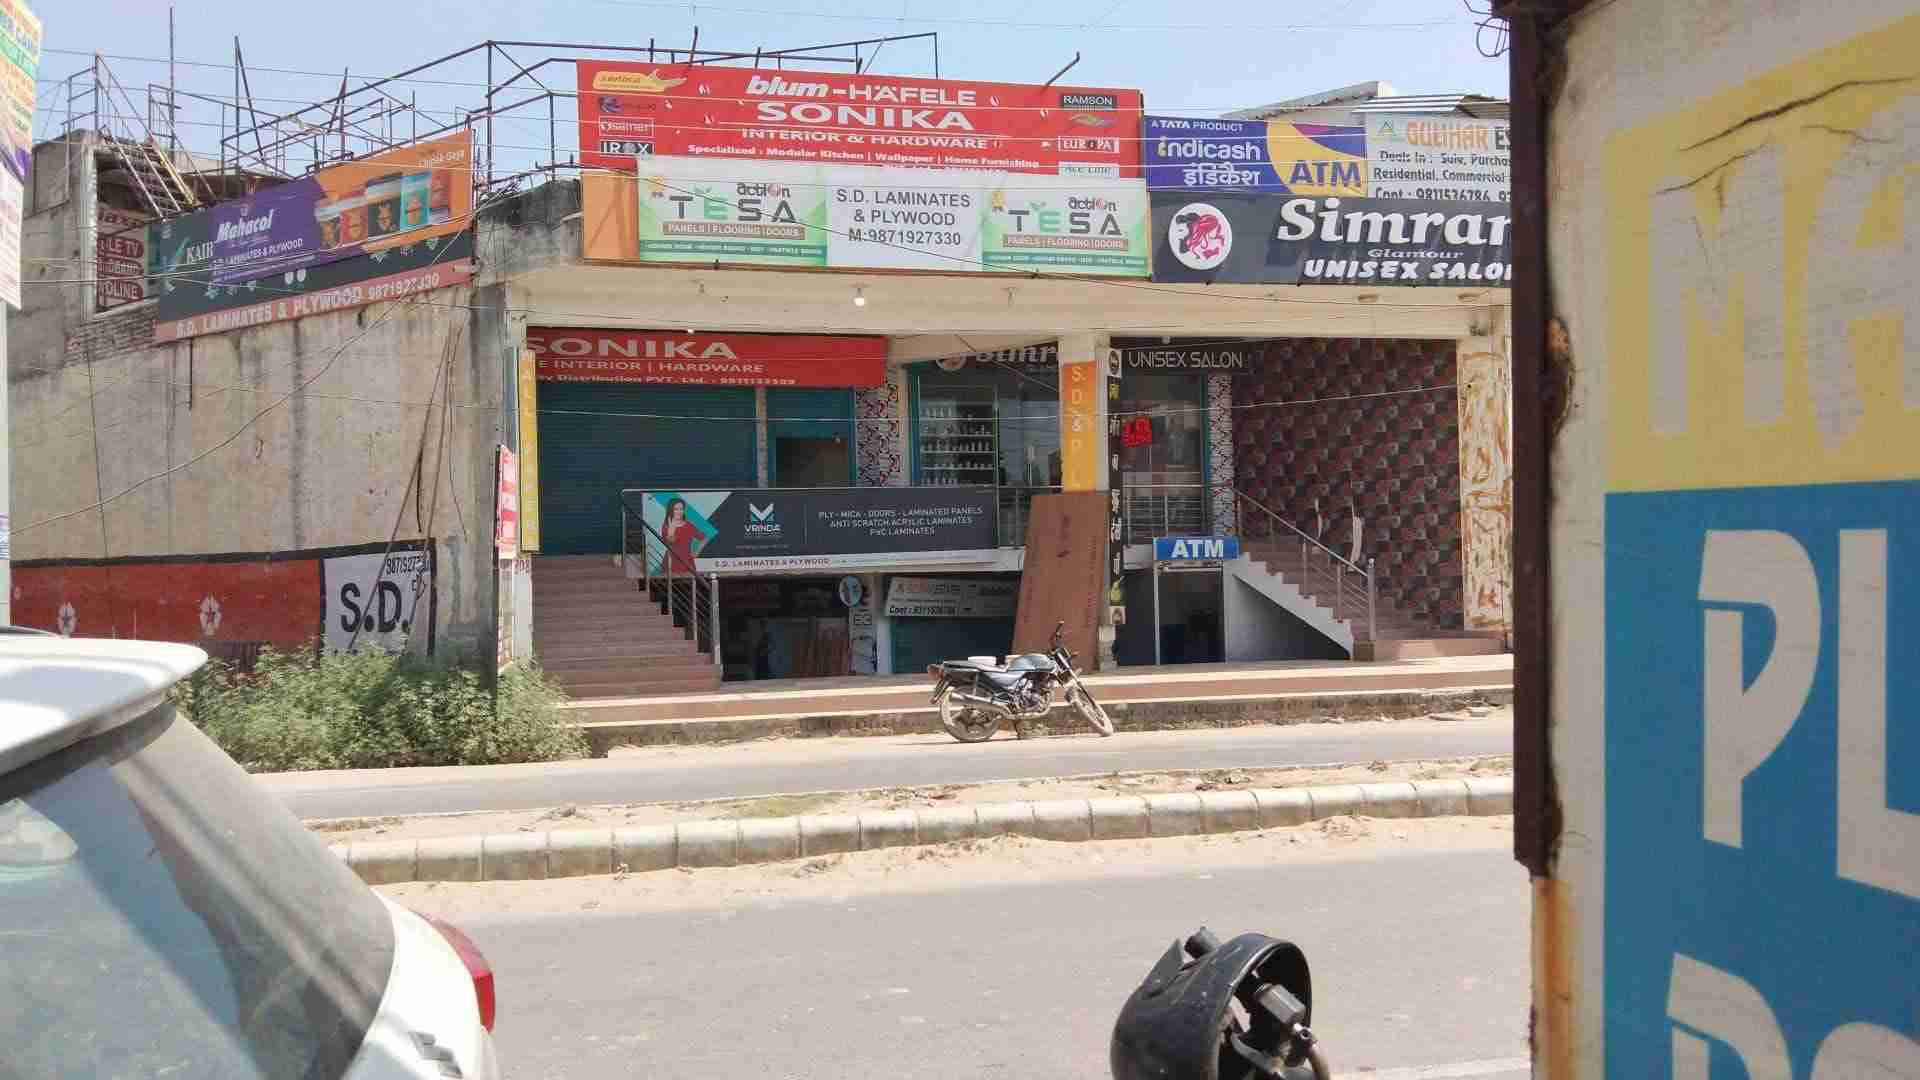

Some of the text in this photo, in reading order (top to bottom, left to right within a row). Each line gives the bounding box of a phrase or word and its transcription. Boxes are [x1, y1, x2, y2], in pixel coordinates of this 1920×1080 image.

[1063, 95, 1113, 105] RAMSON
[756, 101, 975, 130] SONIKA
[1151, 120, 1243, 131] A TATA PRODUCT
[742, 129, 988, 149] INTERIOR & HARDWARE
[1158, 136, 1261, 160] indicash
[945, 156, 978, 165] Home
[1289, 161, 1363, 187] ATM
[1373, 167, 1505, 183] Residential, Commercial
[836, 189, 971, 208] S.D. LAMINATES
[669, 195, 796, 222] TESA
[854, 208, 956, 226] & PLYWOOD
[1008, 209, 1122, 235] TESA
[848, 227, 961, 246] M:9871927330
[1367, 248, 1464, 259] Glamour
[1304, 260, 1419, 279] UNISEX
[554, 360, 641, 369] INTERIOR
[659, 362, 765, 373] HARDWARE
[1128, 351, 1243, 367] UNISEX SALON
[951, 507, 983, 515] PANELS
[1171, 539, 1223, 558] ATM
[340, 581, 409, 632] S.D.
